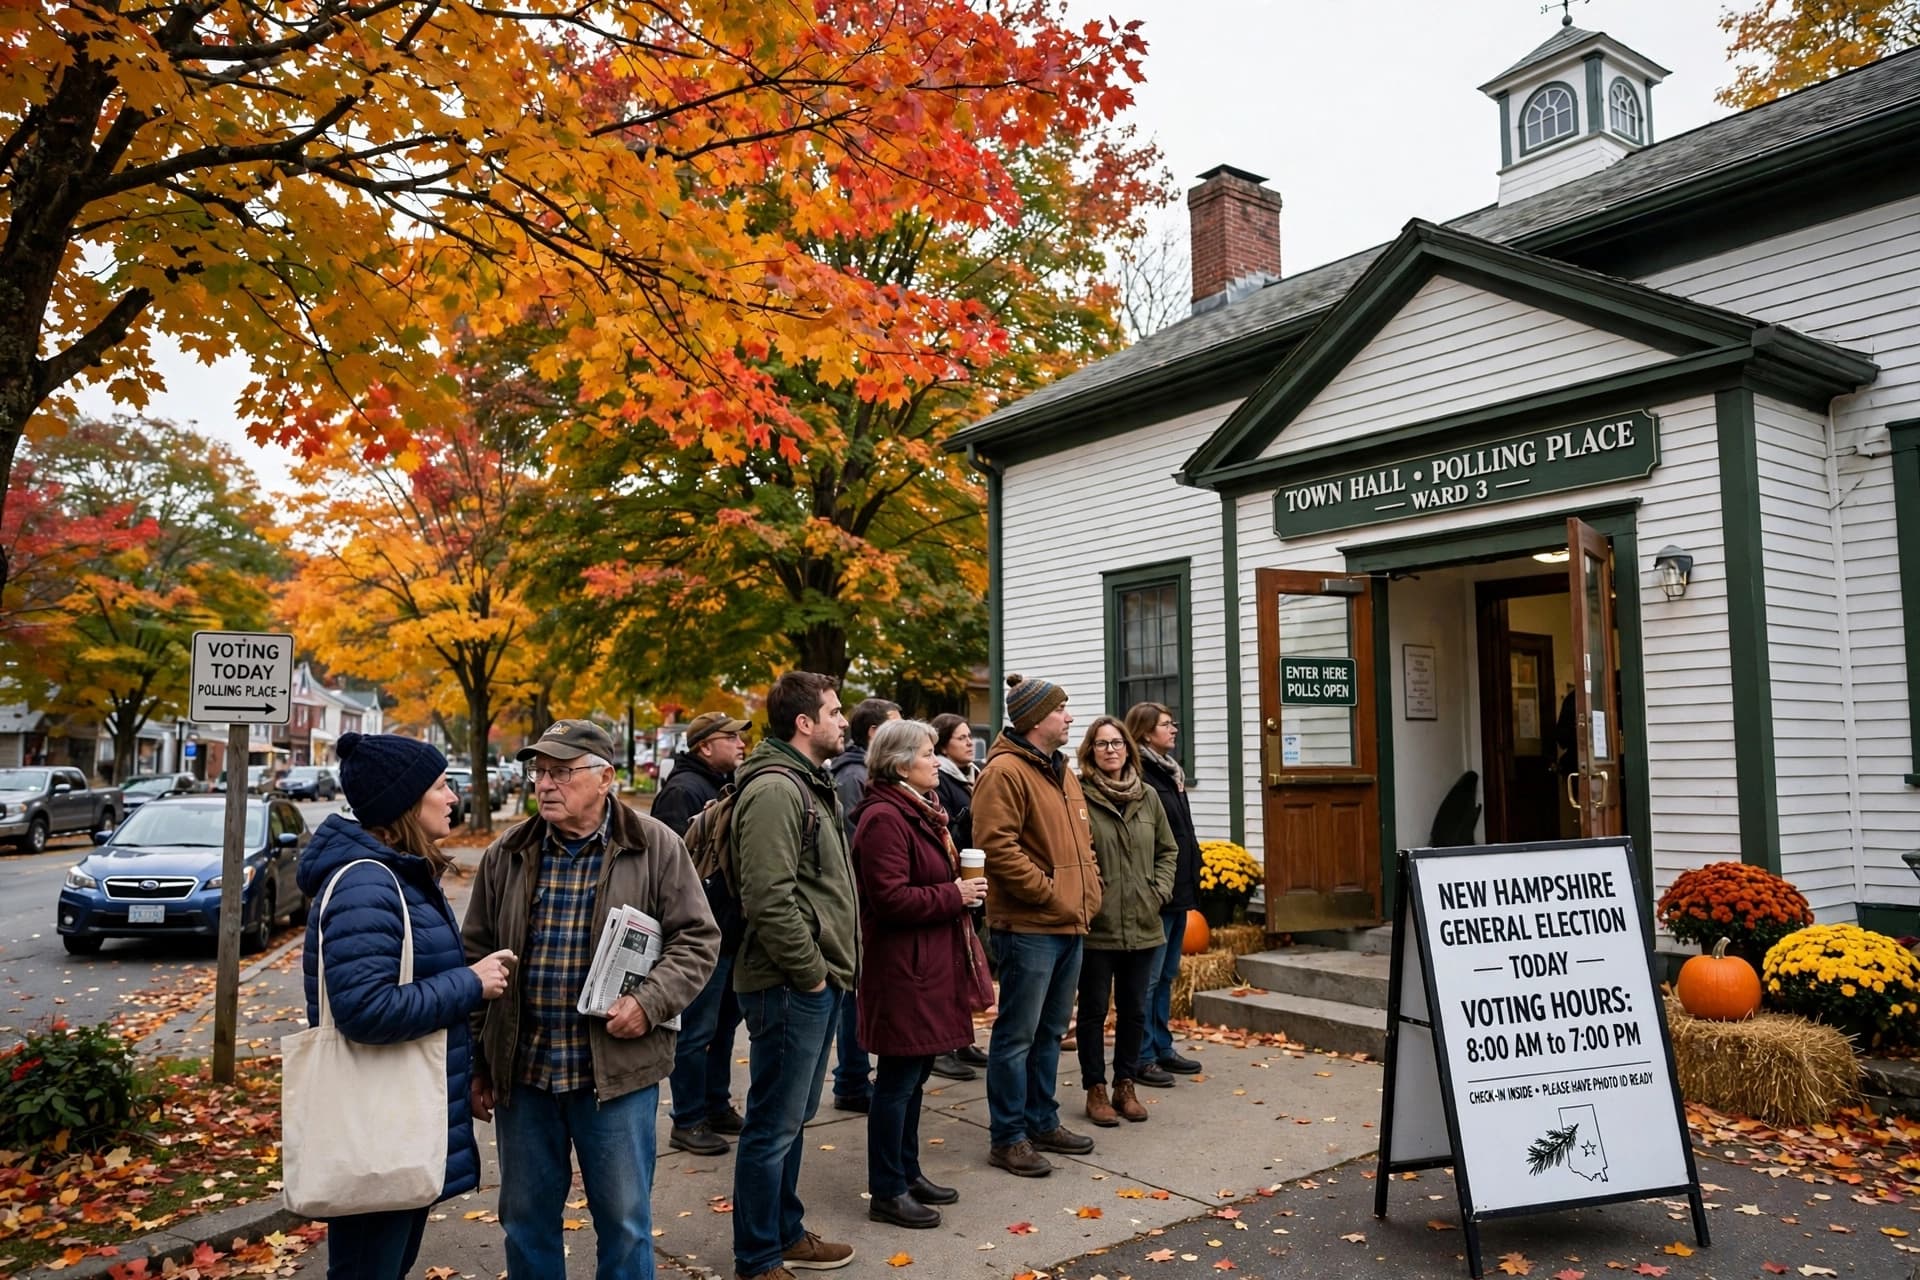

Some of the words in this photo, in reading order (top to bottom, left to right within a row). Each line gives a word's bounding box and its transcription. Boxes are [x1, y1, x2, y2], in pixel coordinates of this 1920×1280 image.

[1285, 481, 1342, 512] TOWN
[1350, 469, 1406, 500] HALL
[1432, 441, 1536, 483] POLLING
[1546, 420, 1635, 462] PLACE
[1411, 484, 1469, 510] WARD
[1476, 480, 1488, 499] 3
[208, 642, 279, 660] VOTING
[211, 663, 274, 680] TODAY
[1286, 666, 1319, 679] ENTER
[1322, 666, 1348, 680] HERE
[198, 684, 242, 697] POLLING
[245, 685, 277, 697] PLACE
[1288, 683, 1320, 697] POLLS
[1323, 683, 1349, 698] OPEN
[1438, 880, 1487, 910] NEW
[1493, 872, 1615, 904] HAMPSHIRE
[1440, 914, 1532, 946] GENERAL
[1535, 907, 1626, 938] ELECTION
[1509, 951, 1569, 979] TODAY
[1461, 993, 1546, 1028] VOTING
[1550, 986, 1632, 1020] HOURS:
[1467, 1035, 1509, 1063] 8:00
[1515, 1031, 1543, 1059] AM
[1547, 1032, 1566, 1054] to
[1569, 1024, 1609, 1052] 7:00
[1614, 1022, 1641, 1047] PM
[1469, 1088, 1506, 1104] CHECK-IN
[1508, 1085, 1534, 1100] INSIDE
[1542, 1081, 1571, 1096] PLEASE
[1593, 1076, 1618, 1090] PHOTO
[1619, 1074, 1628, 1087] ID
[1629, 1072, 1653, 1086] READY
